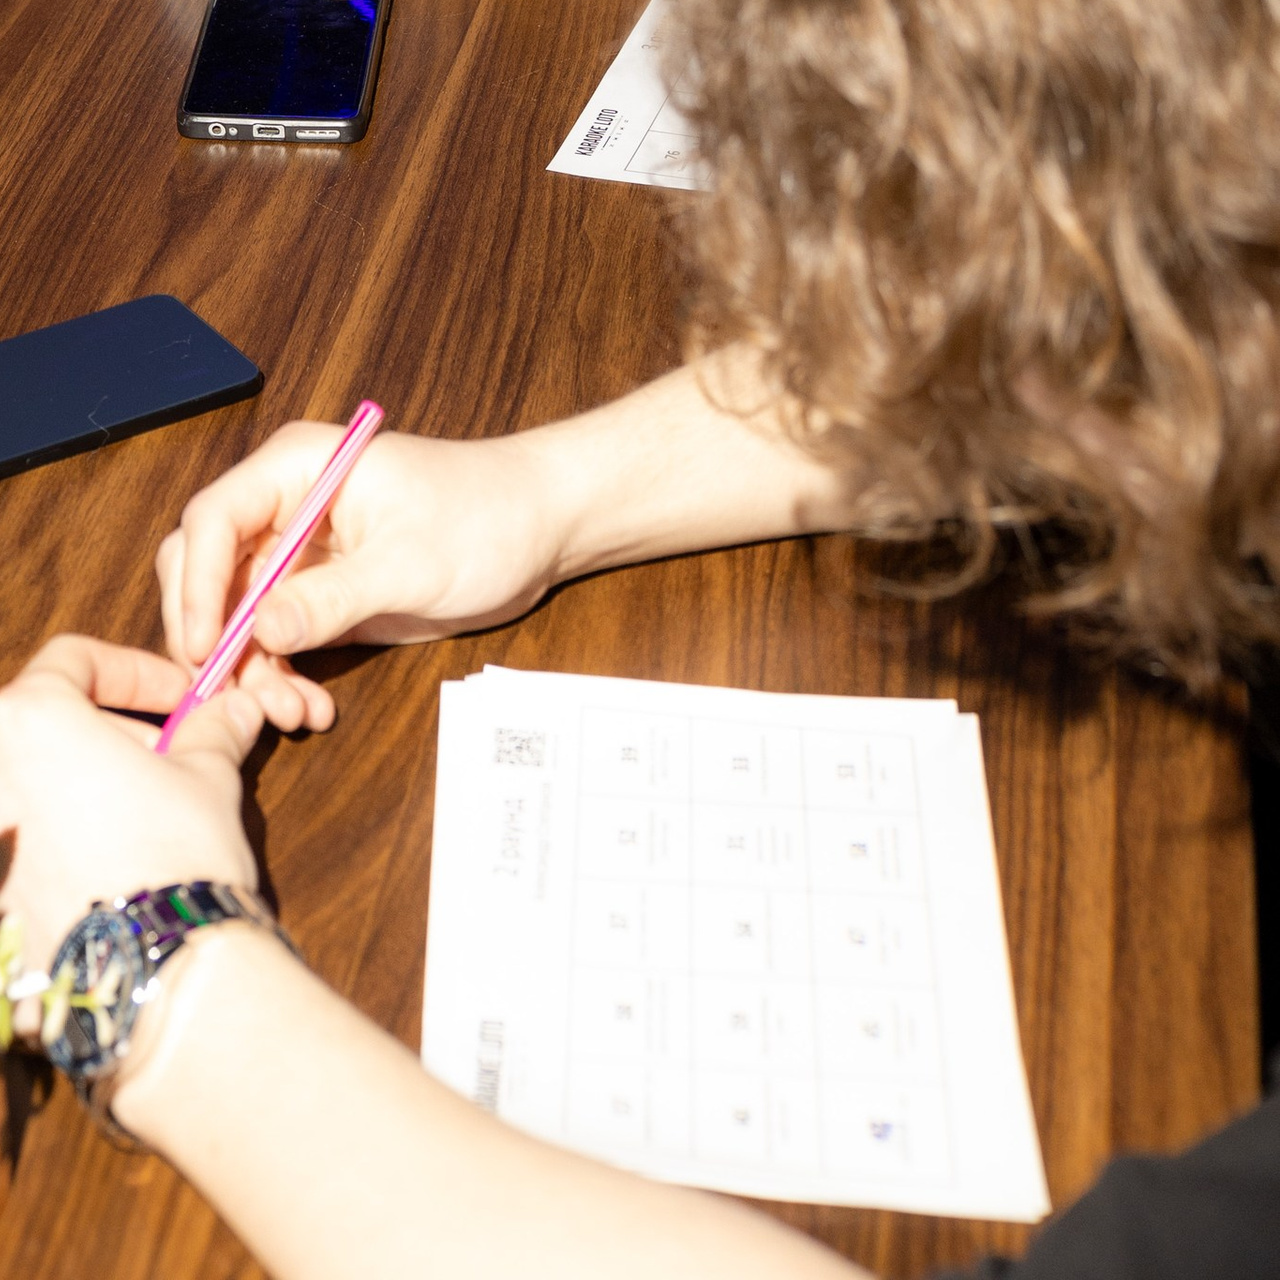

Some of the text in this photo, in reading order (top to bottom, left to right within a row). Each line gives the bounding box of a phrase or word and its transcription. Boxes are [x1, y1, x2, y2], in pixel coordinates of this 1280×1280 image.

[574, 125, 609, 157] KARAOKE
[593, 108, 619, 126] LOTO
[664, 150, 681, 161] 76
